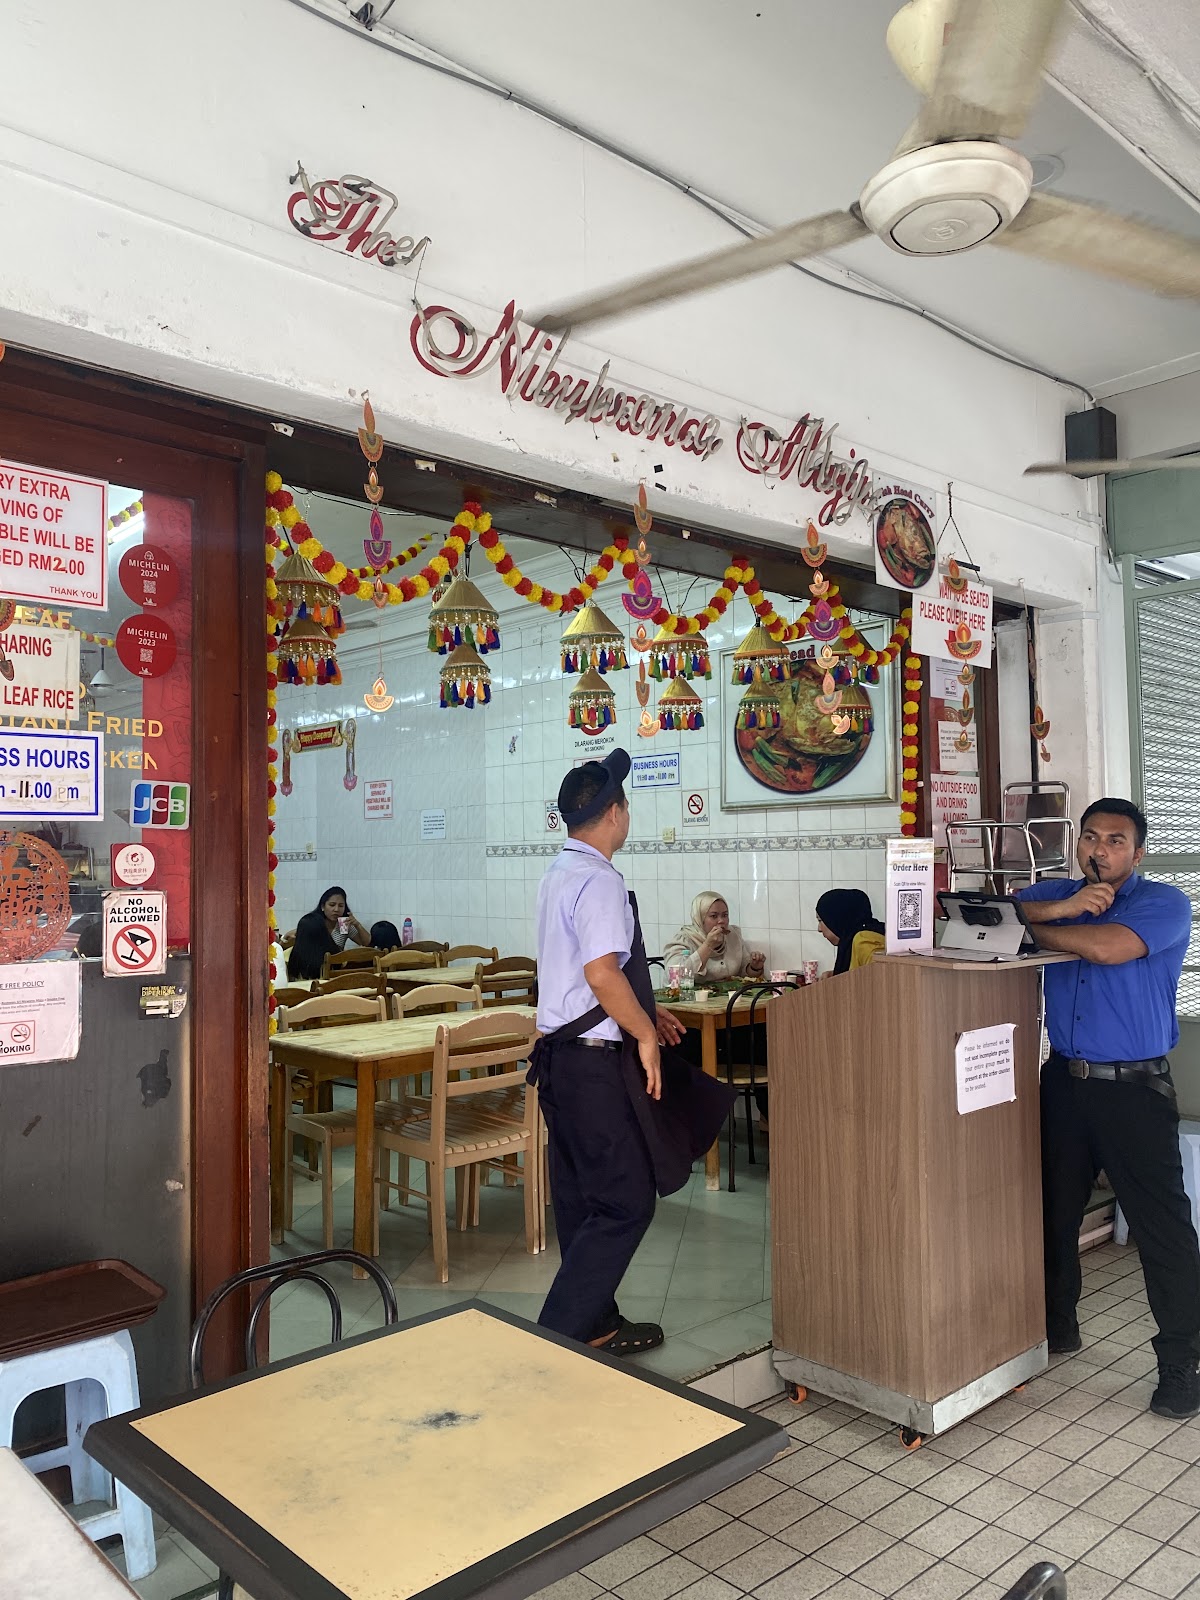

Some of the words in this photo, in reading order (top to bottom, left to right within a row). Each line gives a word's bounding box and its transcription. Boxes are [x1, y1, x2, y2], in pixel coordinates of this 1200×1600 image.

[286, 166, 430, 267] The
[20, 477, 70, 501] EXTRA
[894, 485, 913, 499] Head
[914, 494, 935, 519] Curry
[43, 507, 63, 523] OF
[34, 528, 70, 549] WILL
[75, 535, 94, 553] BE
[29, 552, 85, 576] RM2.00
[128, 559, 170, 572] MICHELIN
[141, 569, 158, 578] 2024
[50, 586, 78, 597] THANK
[81, 590, 98, 599] YOU
[970, 590, 990, 609] SEATED
[13, 607, 72, 629] EAF
[920, 601, 945, 622] PLEASE
[969, 612, 986, 631] HERE
[126, 627, 168, 640] MICHELIN
[138, 637, 156, 646] 2023
[790, 645, 815, 660] ead
[4, 686, 39, 706] LEAF
[44, 688, 74, 710] RICE
[88, 711, 164, 737] FRIED
[574, 739, 594, 748] DILARANG
[595, 737, 615, 745] MEROKOK
[27, 749, 90, 769] HOURS
[104, 750, 158, 770] KEN
[633, 760, 659, 770] BUSINESS
[659, 759, 678, 768] HOURS
[931, 781, 939, 792] NO
[940, 781, 962, 793] OUTSIDE
[963, 783, 978, 795] FOOD
[134, 797, 185, 813] JCB
[936, 797, 948, 808] AND
[948, 798, 967, 809] DRINKS
[942, 812, 968, 823] ALLOWED
[892, 863, 912, 872] Order
[913, 864, 929, 872] Here
[110, 906, 160, 915] ALCOHOL
[109, 914, 160, 923] ALLOWED
[22, 980, 45, 988] POLICY
